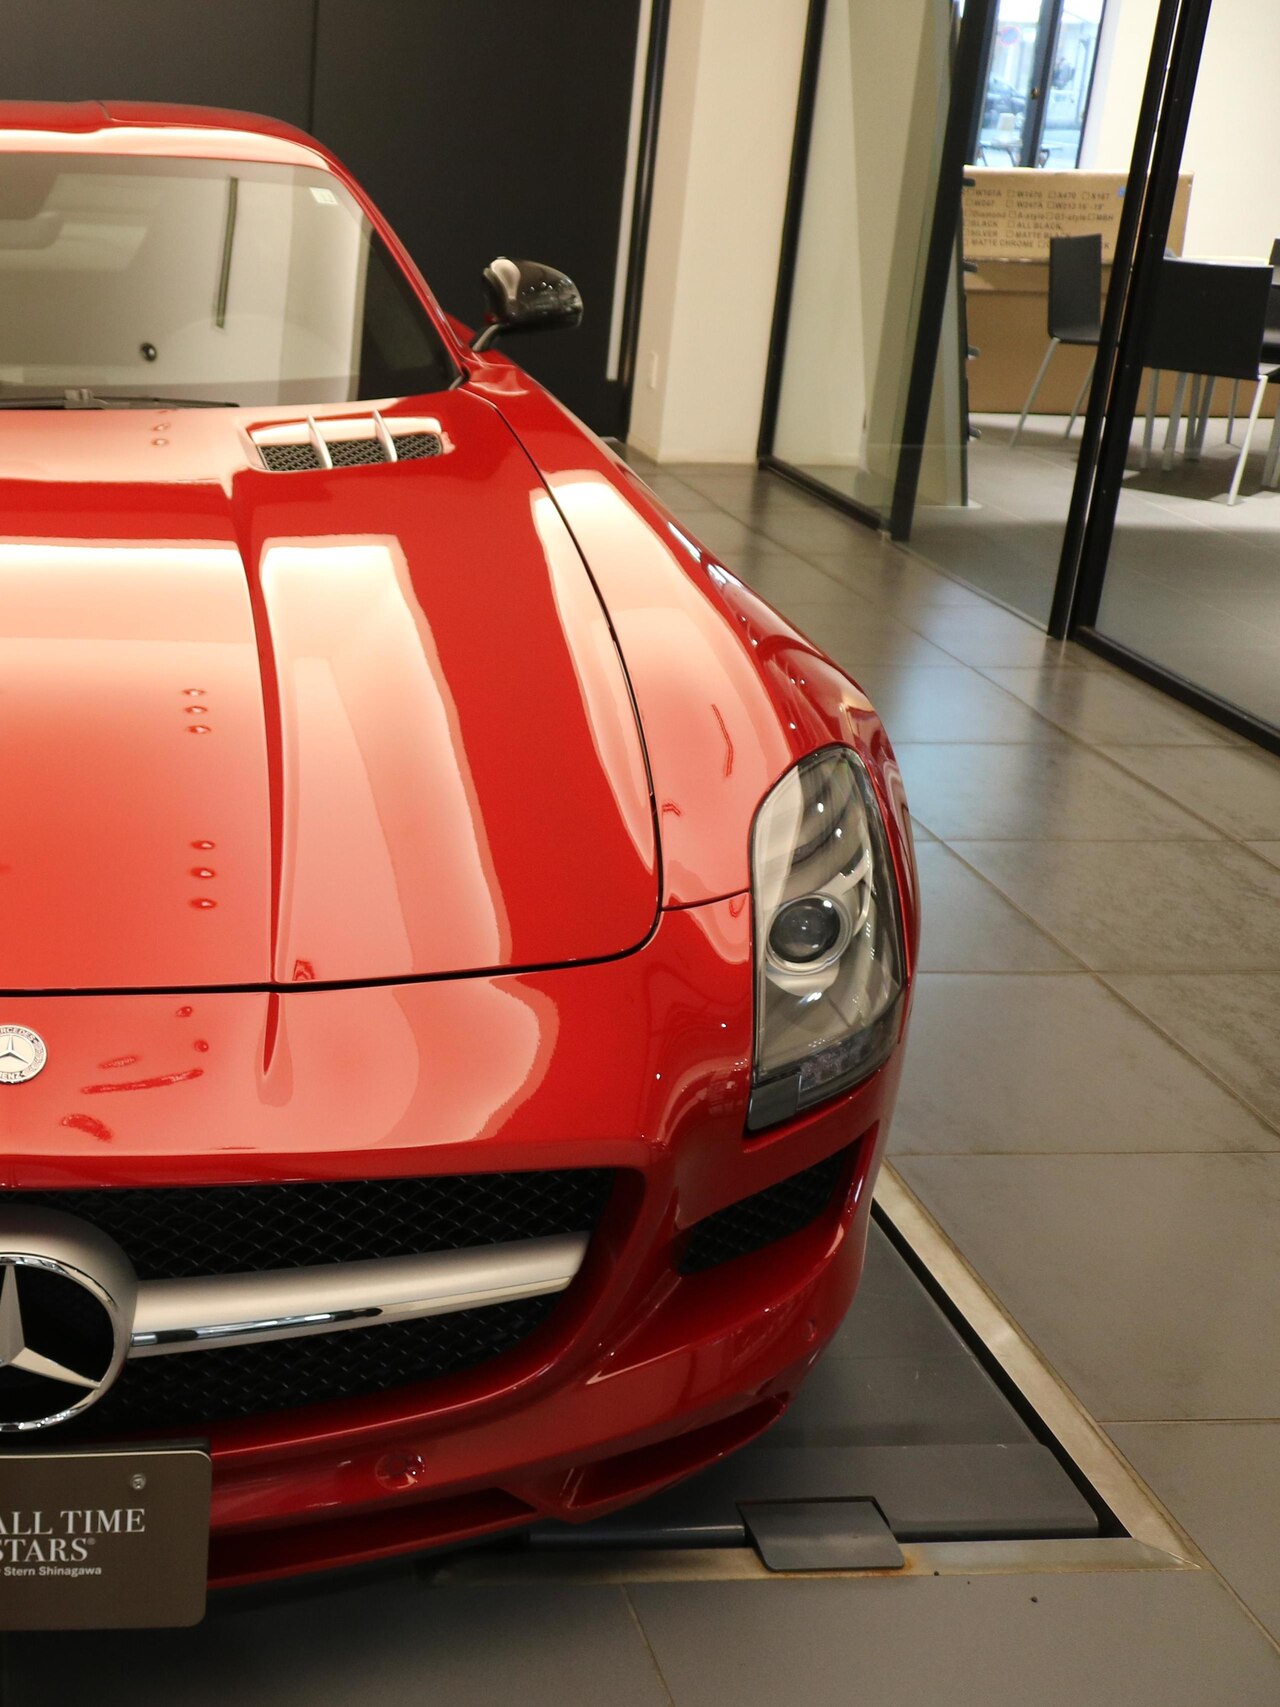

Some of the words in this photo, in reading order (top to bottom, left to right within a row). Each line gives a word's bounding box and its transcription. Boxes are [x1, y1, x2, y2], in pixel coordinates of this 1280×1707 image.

[971, 239, 997, 247] MATTE
[999, 239, 1034, 248] CHROME
[60, 1508, 146, 1534] TIME
[3, 1566, 36, 1577] Stern
[38, 1565, 102, 1578] Shinagawa
